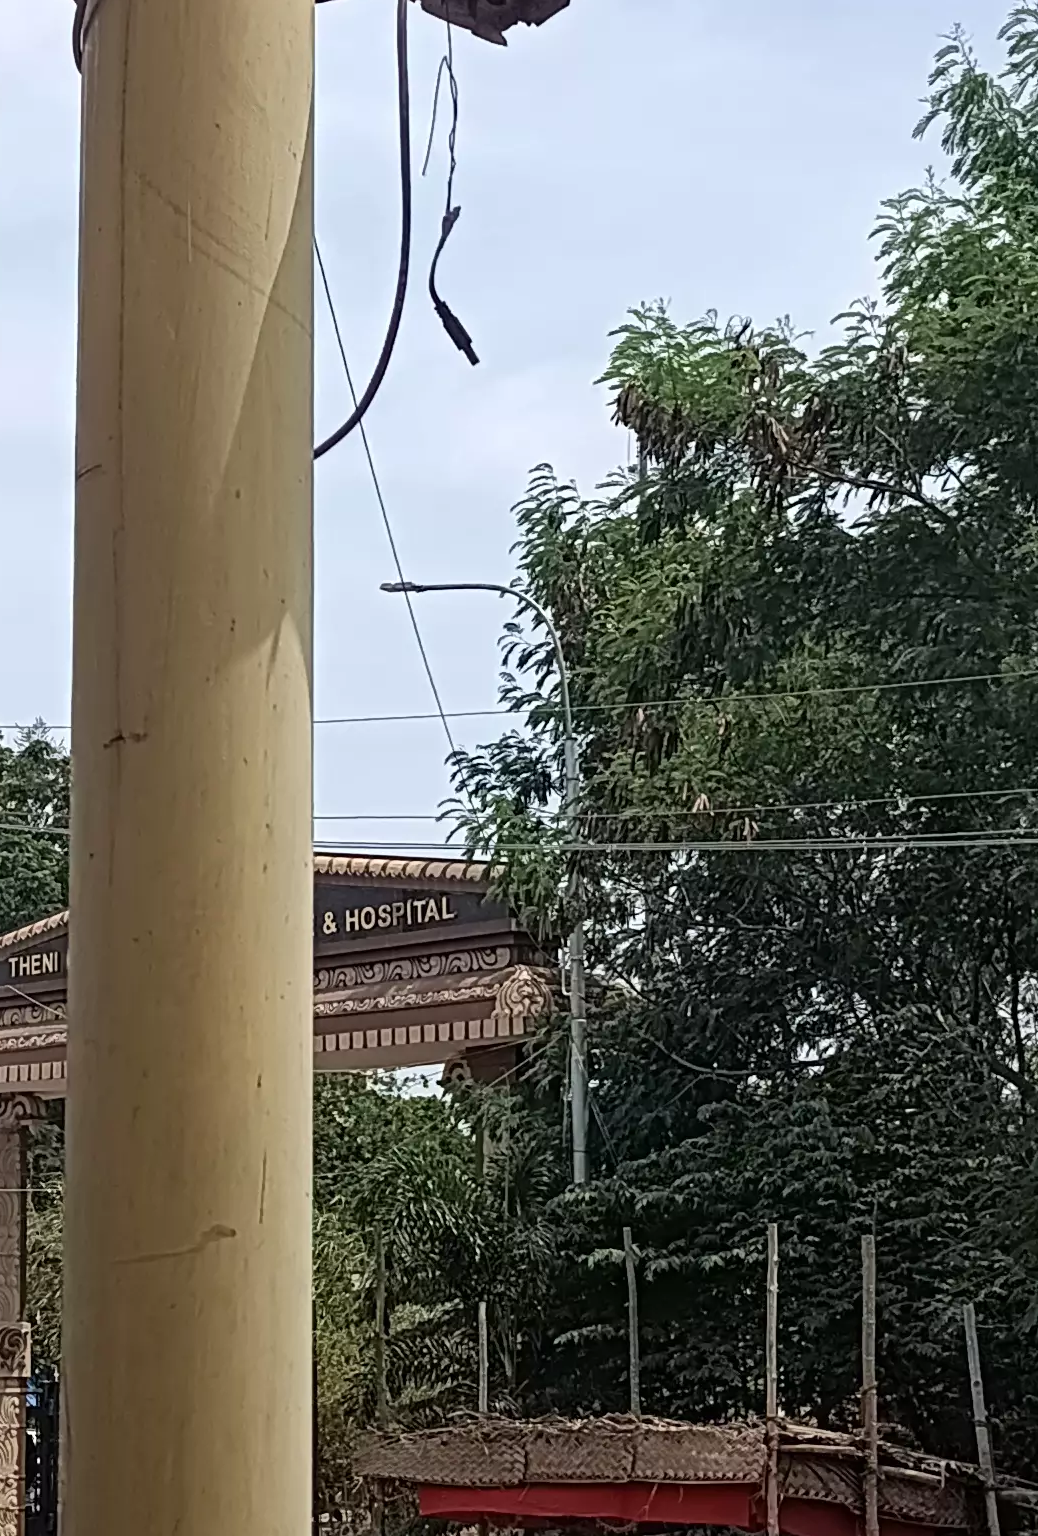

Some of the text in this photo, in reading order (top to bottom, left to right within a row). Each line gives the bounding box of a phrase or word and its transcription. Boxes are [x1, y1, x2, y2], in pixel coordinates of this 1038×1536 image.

[8, 898, 456, 978] THENI & HOSPITAL
